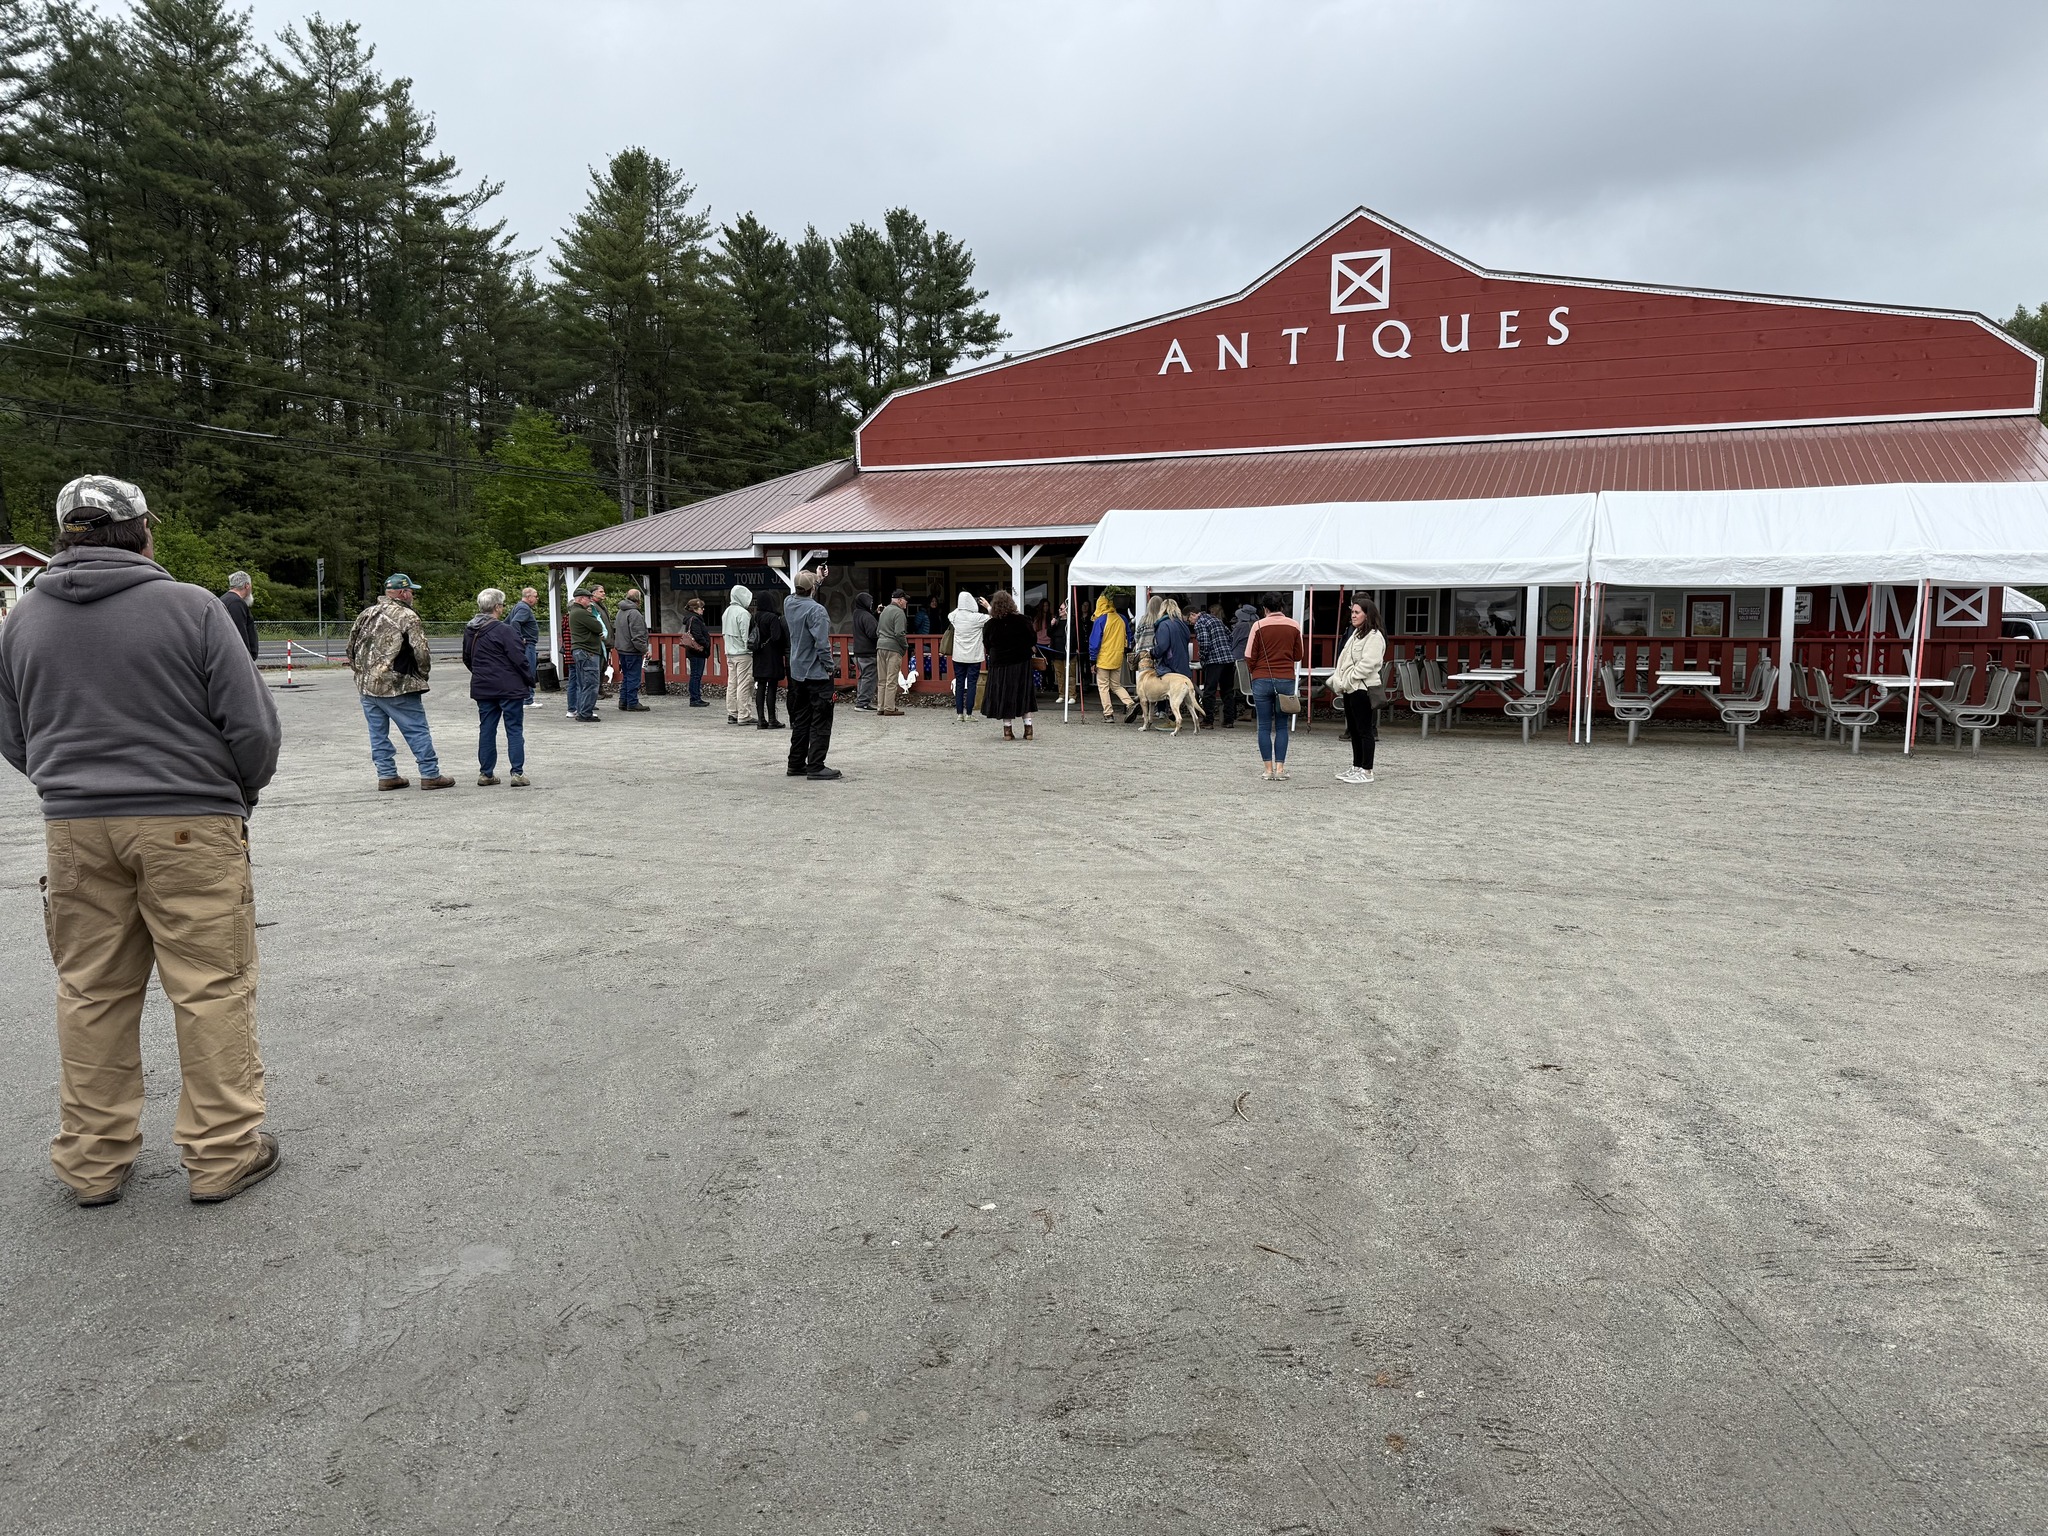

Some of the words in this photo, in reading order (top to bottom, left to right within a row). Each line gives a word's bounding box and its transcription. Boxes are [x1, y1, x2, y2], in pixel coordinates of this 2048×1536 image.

[1157, 306, 1570, 376] ANTIQUES
[679, 573, 726, 585] FRONTIER
[734, 572, 765, 585] TOWN
